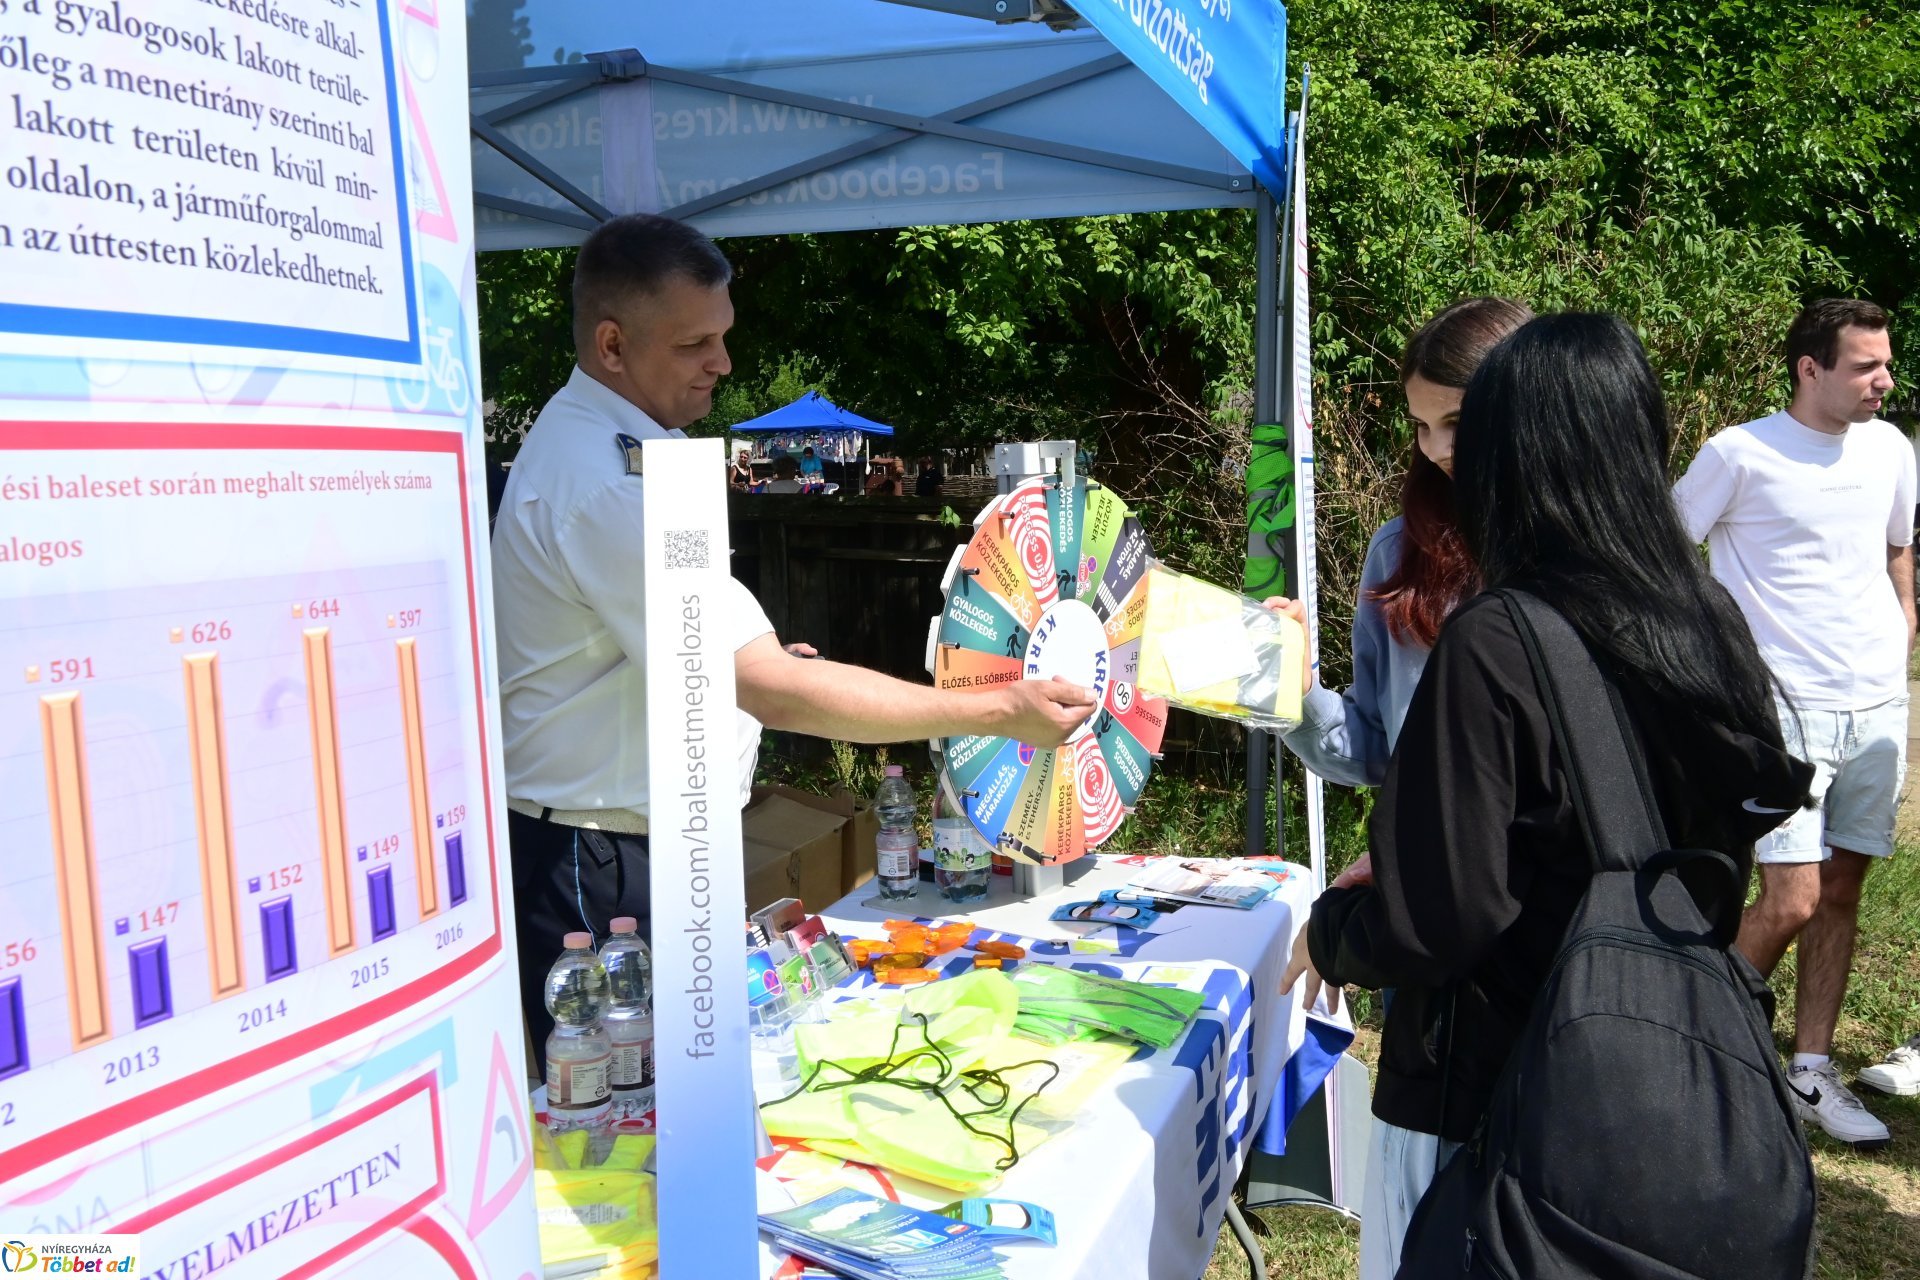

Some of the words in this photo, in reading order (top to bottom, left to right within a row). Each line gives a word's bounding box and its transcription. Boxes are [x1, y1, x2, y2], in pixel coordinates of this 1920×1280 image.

[55, 0, 228, 61] gyalogosok
[234, 34, 301, 85] lakott
[308, 68, 369, 106] terüle-
[315, 20, 365, 60] alkal-
[79, 62, 97, 85] a
[104, 67, 265, 131] menetirány
[269, 101, 345, 147] szerinti
[347, 121, 375, 156] bal
[11, 93, 115, 145] lakott
[132, 125, 260, 172] területen
[271, 146, 326, 189] kívül
[335, 171, 378, 201] min-
[6, 155, 145, 213] oldalon,
[152, 186, 169, 209] a
[172, 181, 385, 250] járműforgalommal
[23, 227, 61, 252] az
[68, 223, 198, 267] úttesten
[203, 237, 384, 295] közlekedhetnek.
[47, 474, 145, 499] baleset
[149, 471, 217, 496] során
[223, 470, 304, 499] meghalt
[308, 470, 391, 496] személyek
[394, 469, 433, 491] száma
[1059, 481, 1067, 553] KÖZLEKEDÉS
[1091, 494, 1107, 544] JELZÉSEK
[1099, 498, 1114, 538] KÖZÚTI
[1129, 529, 1139, 543] AZ
[982, 532, 1020, 588] KERÉKPÁROS
[1019, 495, 1039, 552] PÖRGESS
[1034, 553, 1050, 590] ÚJRA!
[1116, 542, 1134, 568] ÚTON
[1122, 540, 1147, 581] HALADÁS
[976, 541, 1014, 597] KÖZLEKEDÉS
[307, 598, 341, 620] 644
[398, 609, 423, 629] 597
[949, 608, 998, 645] KÖZLEKEDÉS
[953, 595, 995, 625] GYALOGOS
[190, 619, 233, 643] 626
[48, 656, 97, 684] 591
[941, 674, 974, 690] ELŐZÉS,
[975, 671, 1019, 687] ELSŐBBSÉG
[1117, 683, 1130, 706] 90
[1135, 706, 1163, 728] SEBESSÉG
[1084, 747, 1096, 782] ÚJRA!
[1113, 751, 1139, 792] GYALOGOS
[1114, 735, 1145, 783] KÖZLEKEDÉS
[975, 763, 1010, 819] MEGÁLLÁS,
[981, 767, 1018, 825] VÁRAKOZÁS
[1028, 749, 1053, 832] TEHERSZÁLLÍTÁ
[1092, 782, 1110, 833] PÖRGESS
[446, 805, 467, 826] 159
[682, 594, 713, 1060] facebook.com/balesetmegelozes
[1018, 790, 1034, 838] SZEMÉLY-
[1057, 784, 1066, 856] KERÉKPÁROS
[1064, 784, 1073, 854] KÖZLEKEDÉS
[371, 834, 400, 860] 149
[267, 863, 304, 891] 152
[138, 901, 180, 933] 147
[434, 922, 465, 951] 2016
[350, 957, 390, 989] 2015
[237, 998, 288, 1033] 2014
[102, 1045, 161, 1085] 2013
[140, 1144, 400, 1280] YELMEZETTEN
